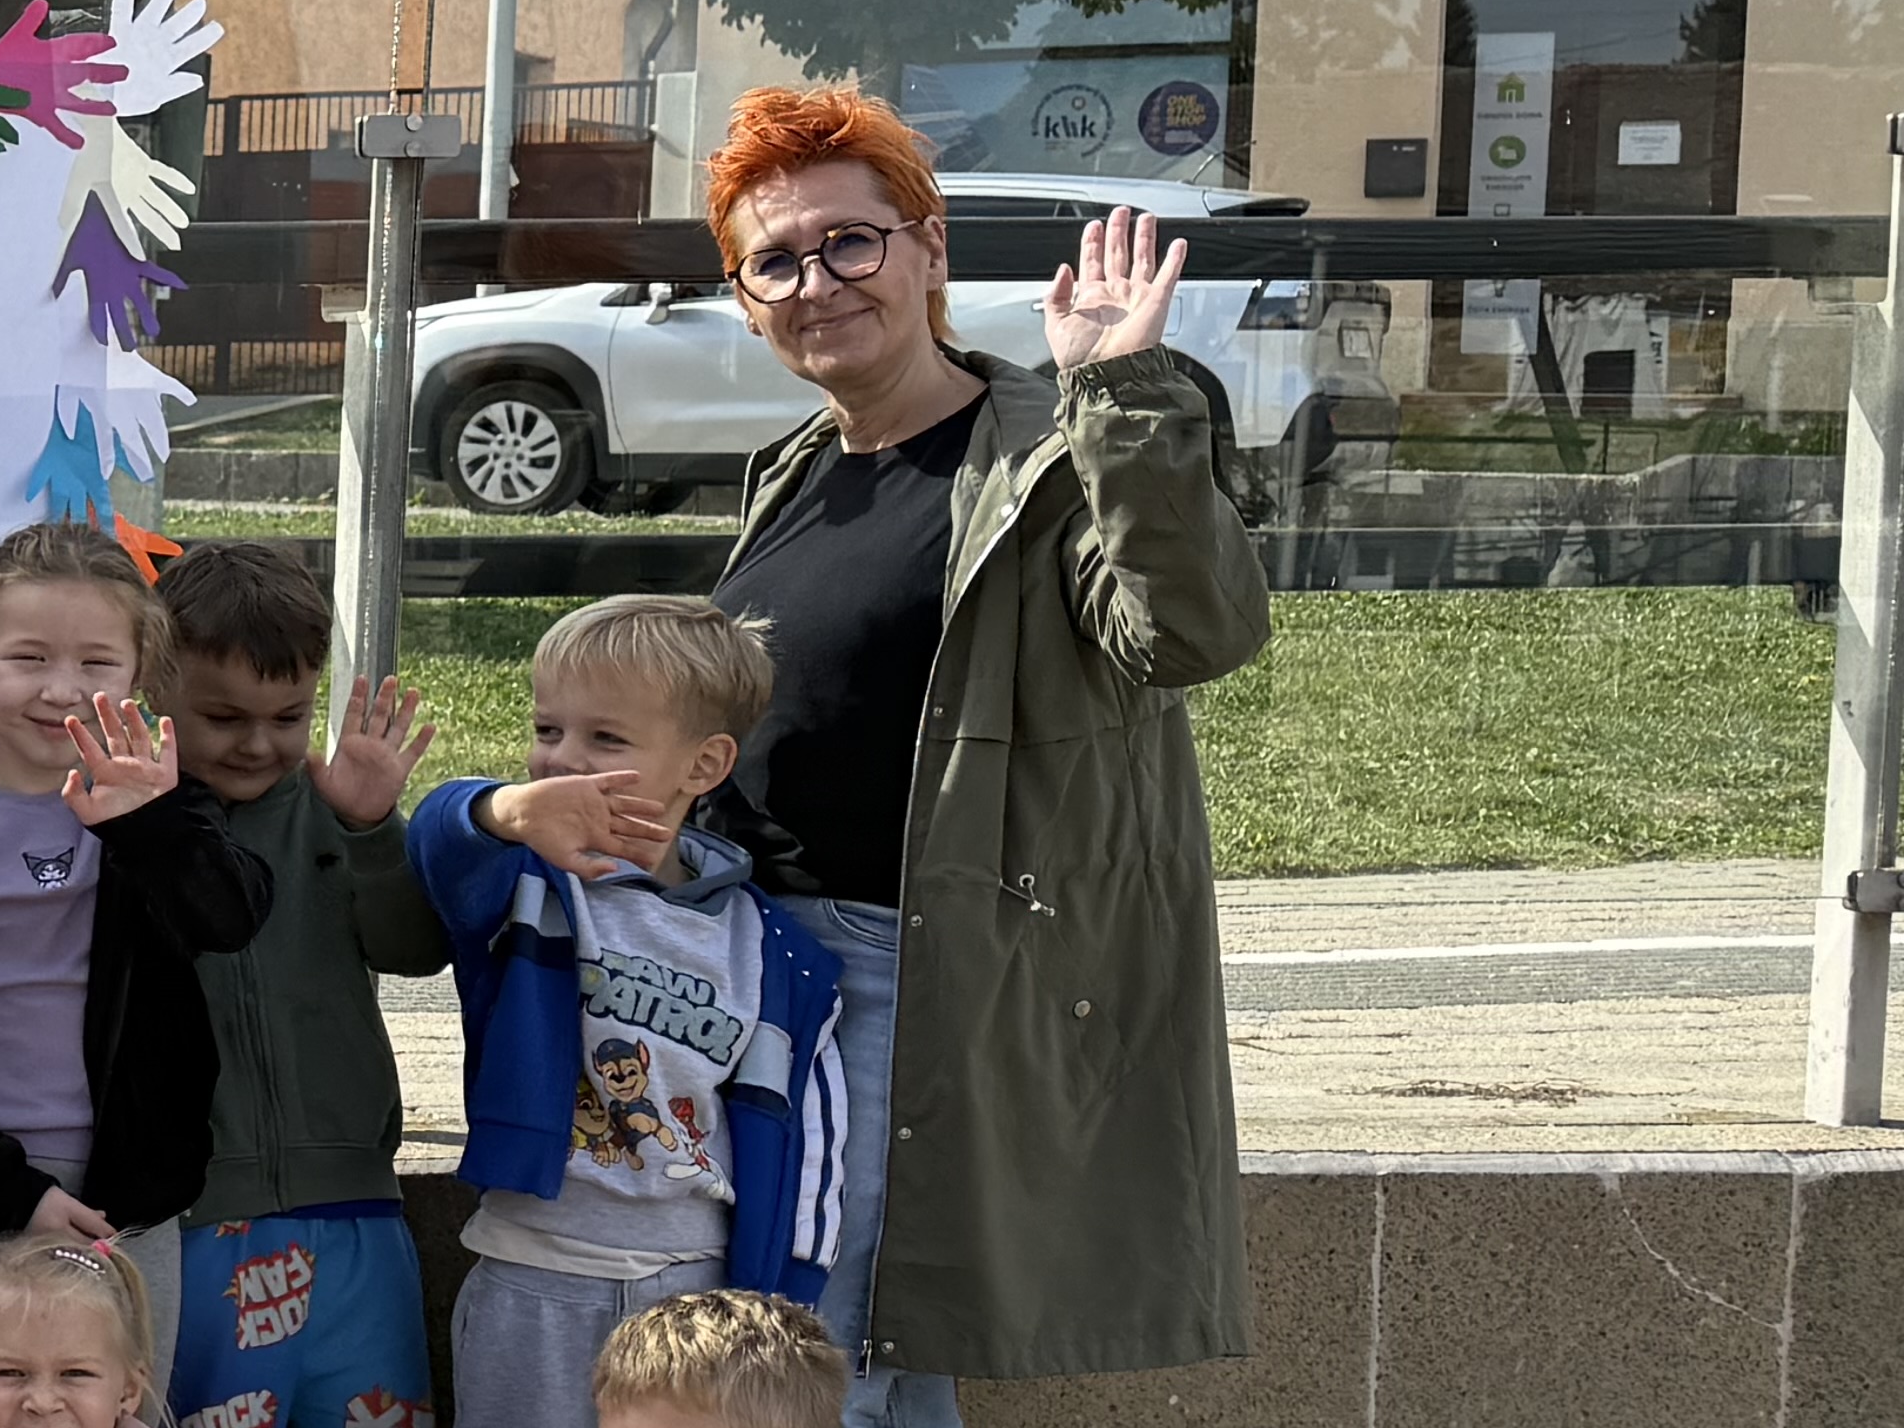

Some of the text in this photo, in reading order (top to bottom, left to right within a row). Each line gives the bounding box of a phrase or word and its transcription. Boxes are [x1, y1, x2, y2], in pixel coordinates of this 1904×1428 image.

[1044, 115, 1096, 139] klik
[599, 948, 717, 1007] PAW
[578, 963, 744, 1067] PATROL
[237, 1246, 313, 1308] FAM
